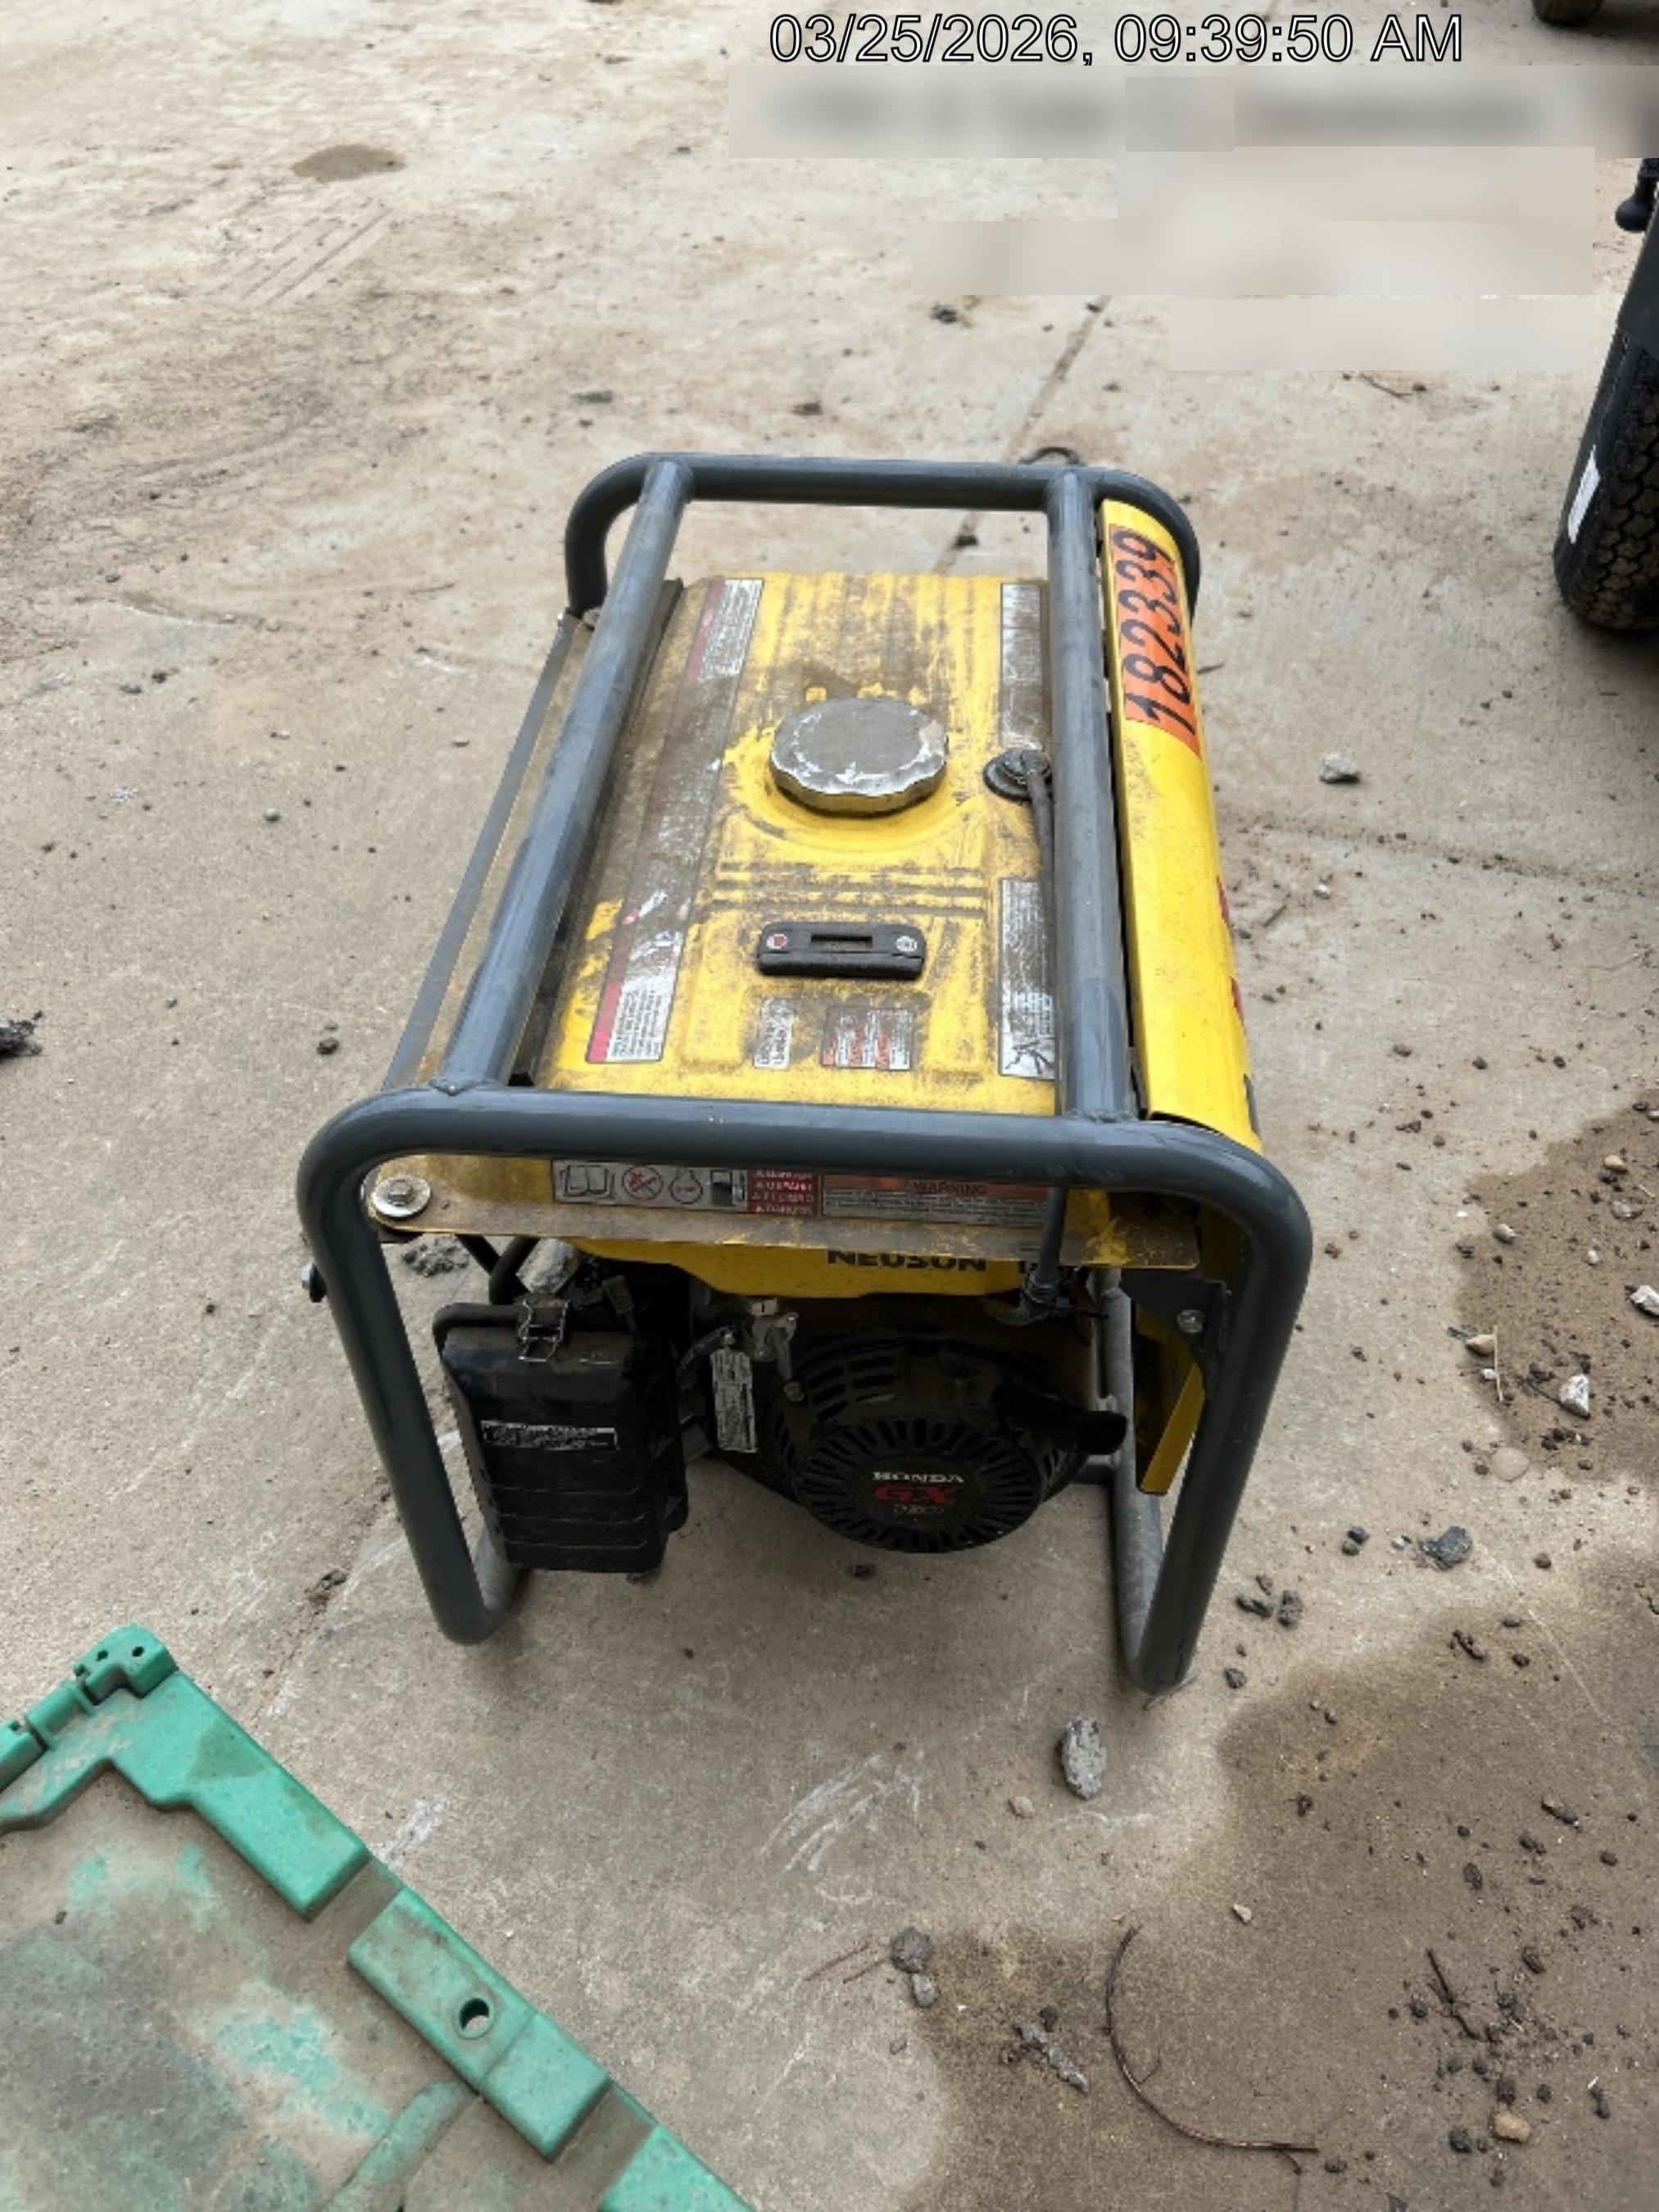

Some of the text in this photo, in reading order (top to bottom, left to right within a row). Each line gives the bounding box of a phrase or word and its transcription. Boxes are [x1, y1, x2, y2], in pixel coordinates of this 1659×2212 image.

[1112, 528, 1196, 736] 182339
[913, 1181, 986, 1195] WARNING
[827, 1250, 986, 1271] NEUSON
[873, 1471, 964, 1483] HONDA
